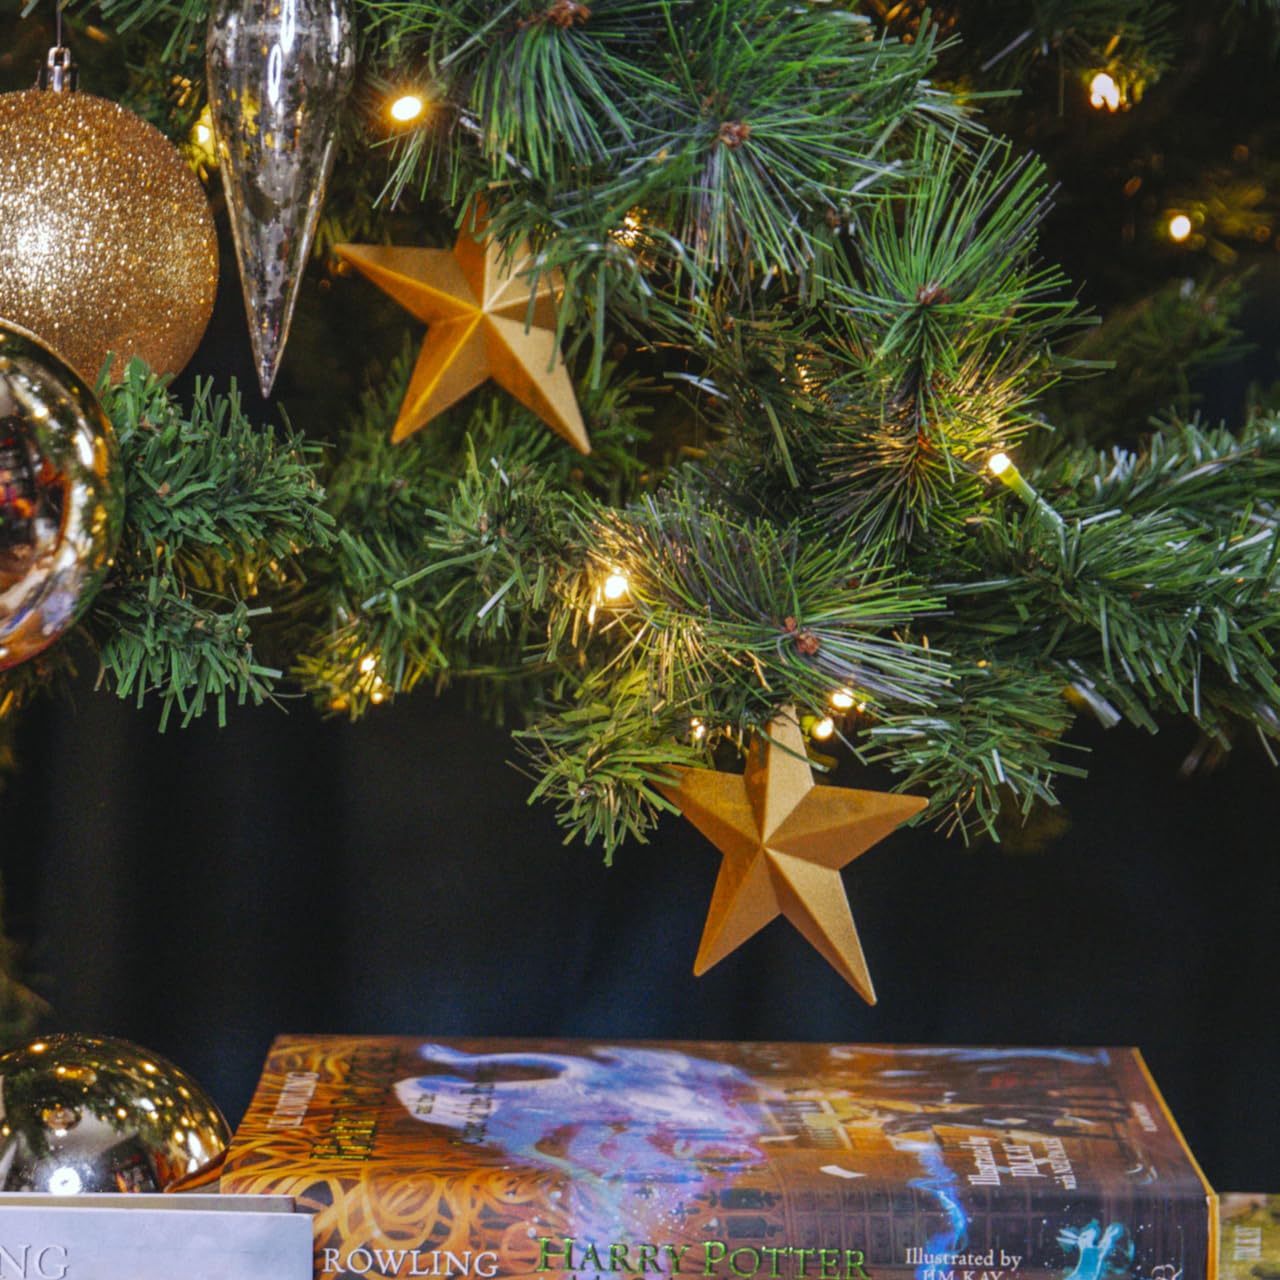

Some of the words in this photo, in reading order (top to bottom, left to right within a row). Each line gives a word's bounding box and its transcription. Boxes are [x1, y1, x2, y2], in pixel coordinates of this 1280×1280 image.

[322, 1247, 499, 1278] ROWLING
[535, 1236, 690, 1277] HARRY
[702, 1240, 873, 1280] POTTER
[905, 1247, 996, 1266] Illustrated
[1000, 1251, 1022, 1271] by
